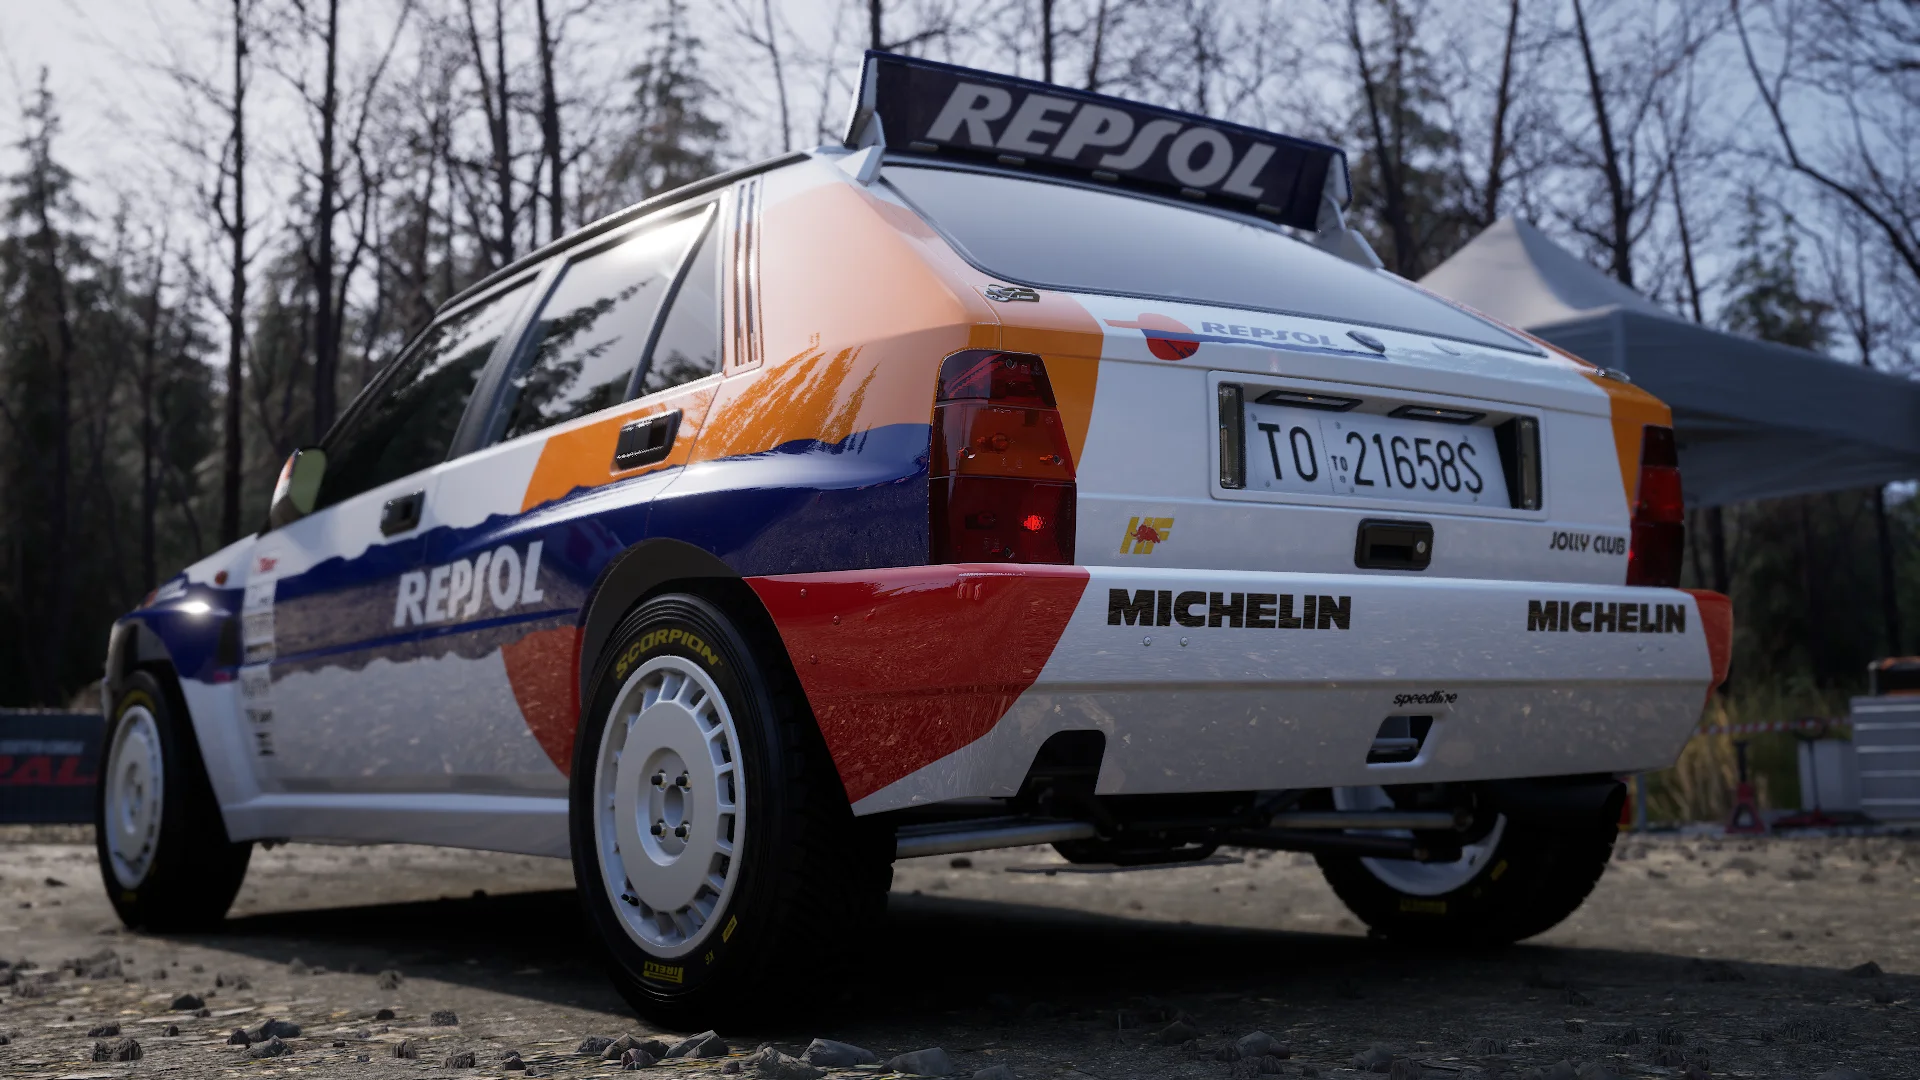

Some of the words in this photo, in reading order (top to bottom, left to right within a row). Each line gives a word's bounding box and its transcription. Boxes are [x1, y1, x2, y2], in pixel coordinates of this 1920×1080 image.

[926, 81, 1277, 199] REPSOL
[1201, 321, 1338, 347] REPSOL
[1257, 422, 1319, 482] TO
[1346, 431, 1484, 494] 21658S
[1119, 516, 1175, 555] HF
[1549, 531, 1590, 552] JOLLY
[1593, 535, 1626, 555] CLUB
[393, 540, 544, 628] REPSOL
[1107, 588, 1352, 630] MICHELIN
[1527, 600, 1686, 633] MICHELIN
[616, 628, 719, 679] SCORPION
[1393, 690, 1458, 707] speedline
[643, 961, 684, 984] PIRELLI
